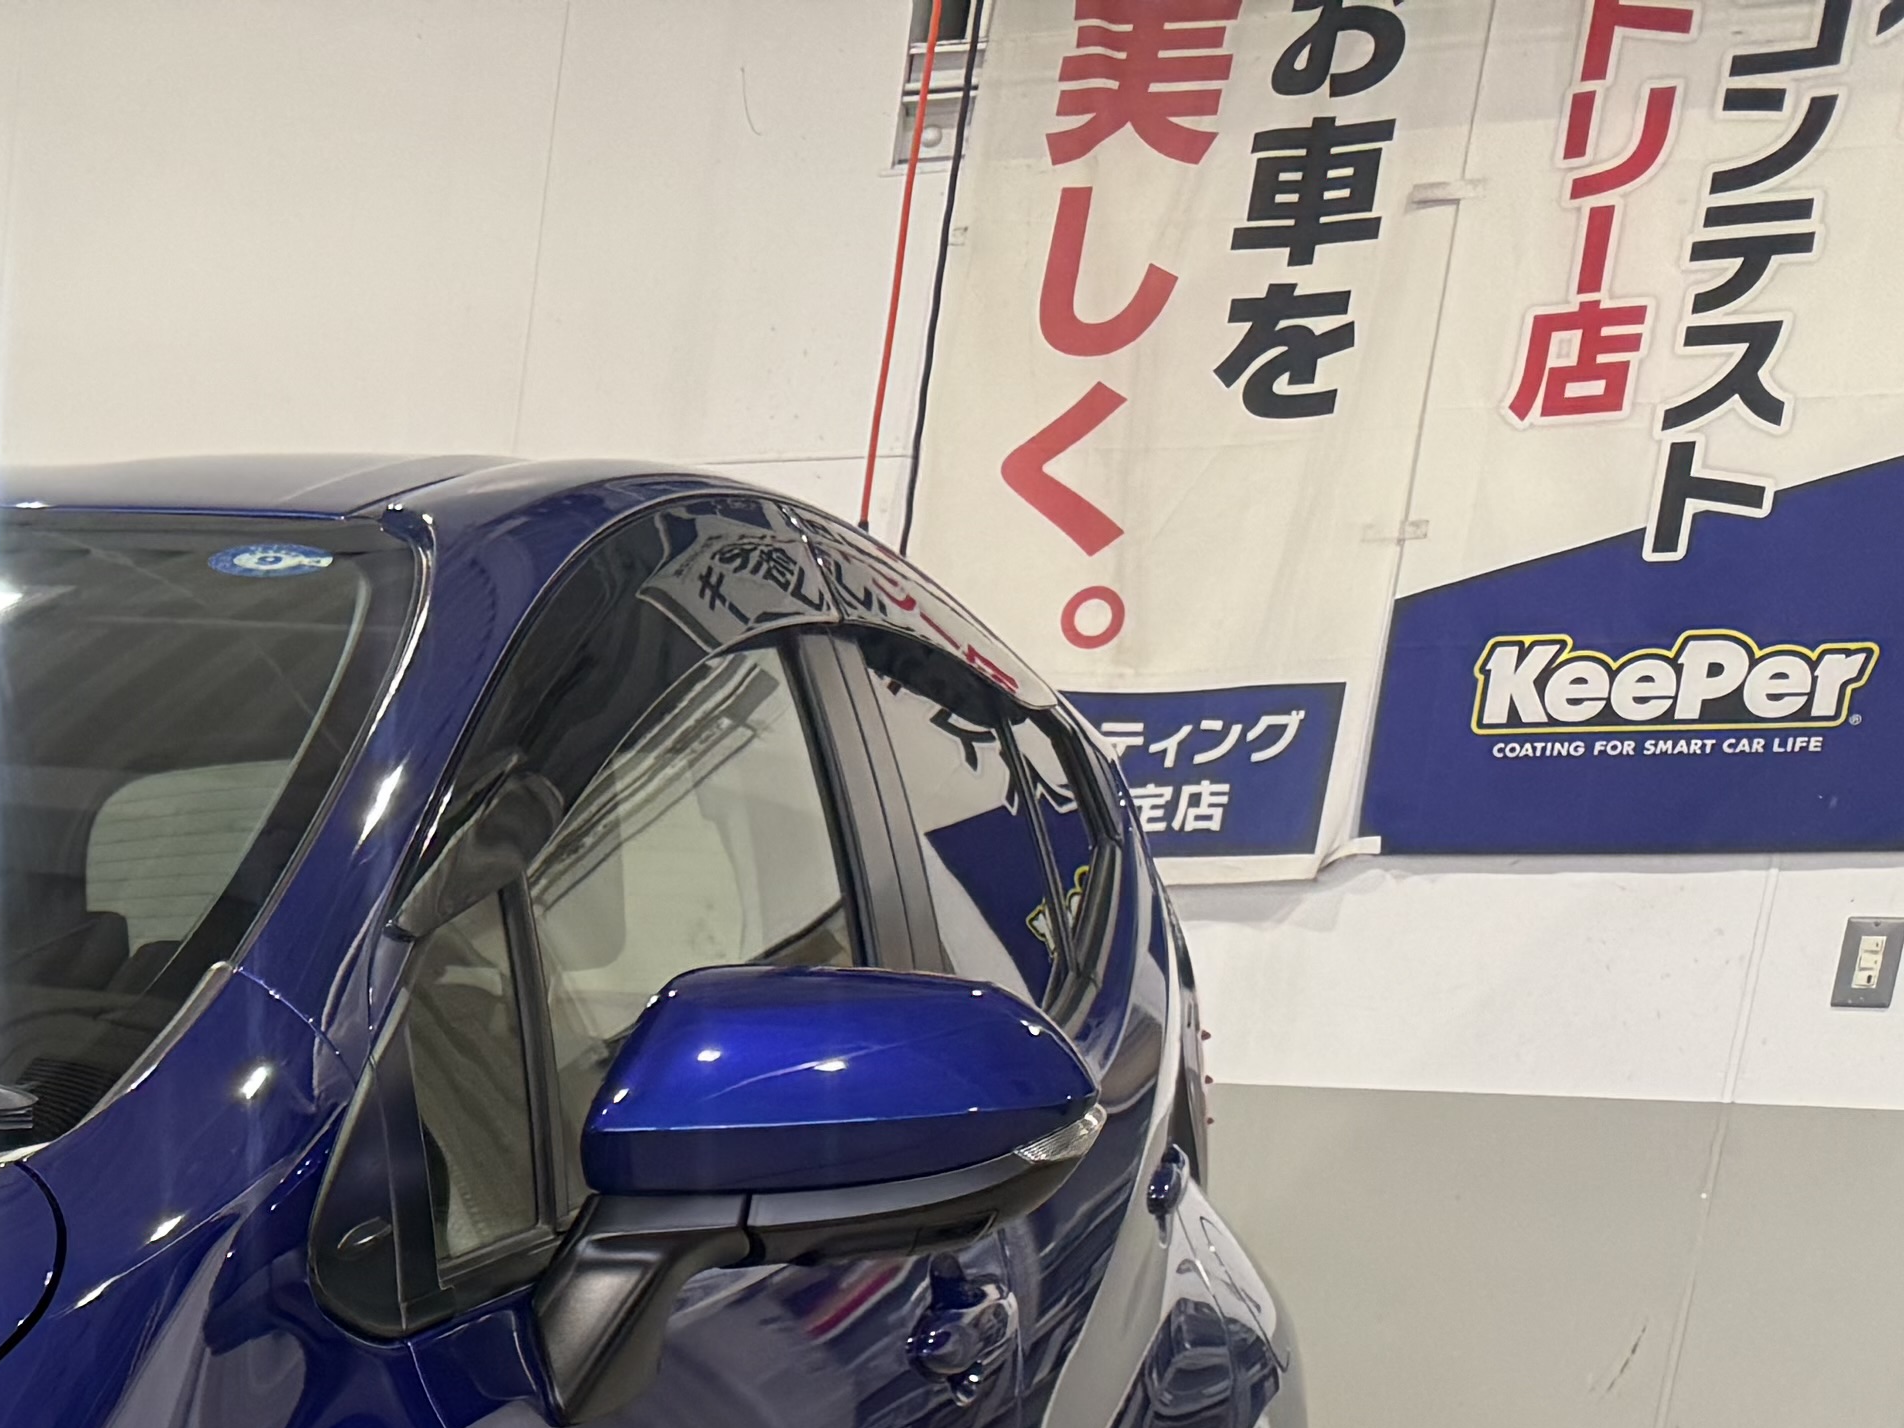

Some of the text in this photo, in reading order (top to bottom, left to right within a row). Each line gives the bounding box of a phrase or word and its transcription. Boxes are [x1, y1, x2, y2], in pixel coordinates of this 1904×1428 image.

[1213, 0, 1406, 420] お車を
[1476, 634, 1876, 731] KeePer
[1491, 736, 1824, 759] COATING FOR SMART CAR LIFE
